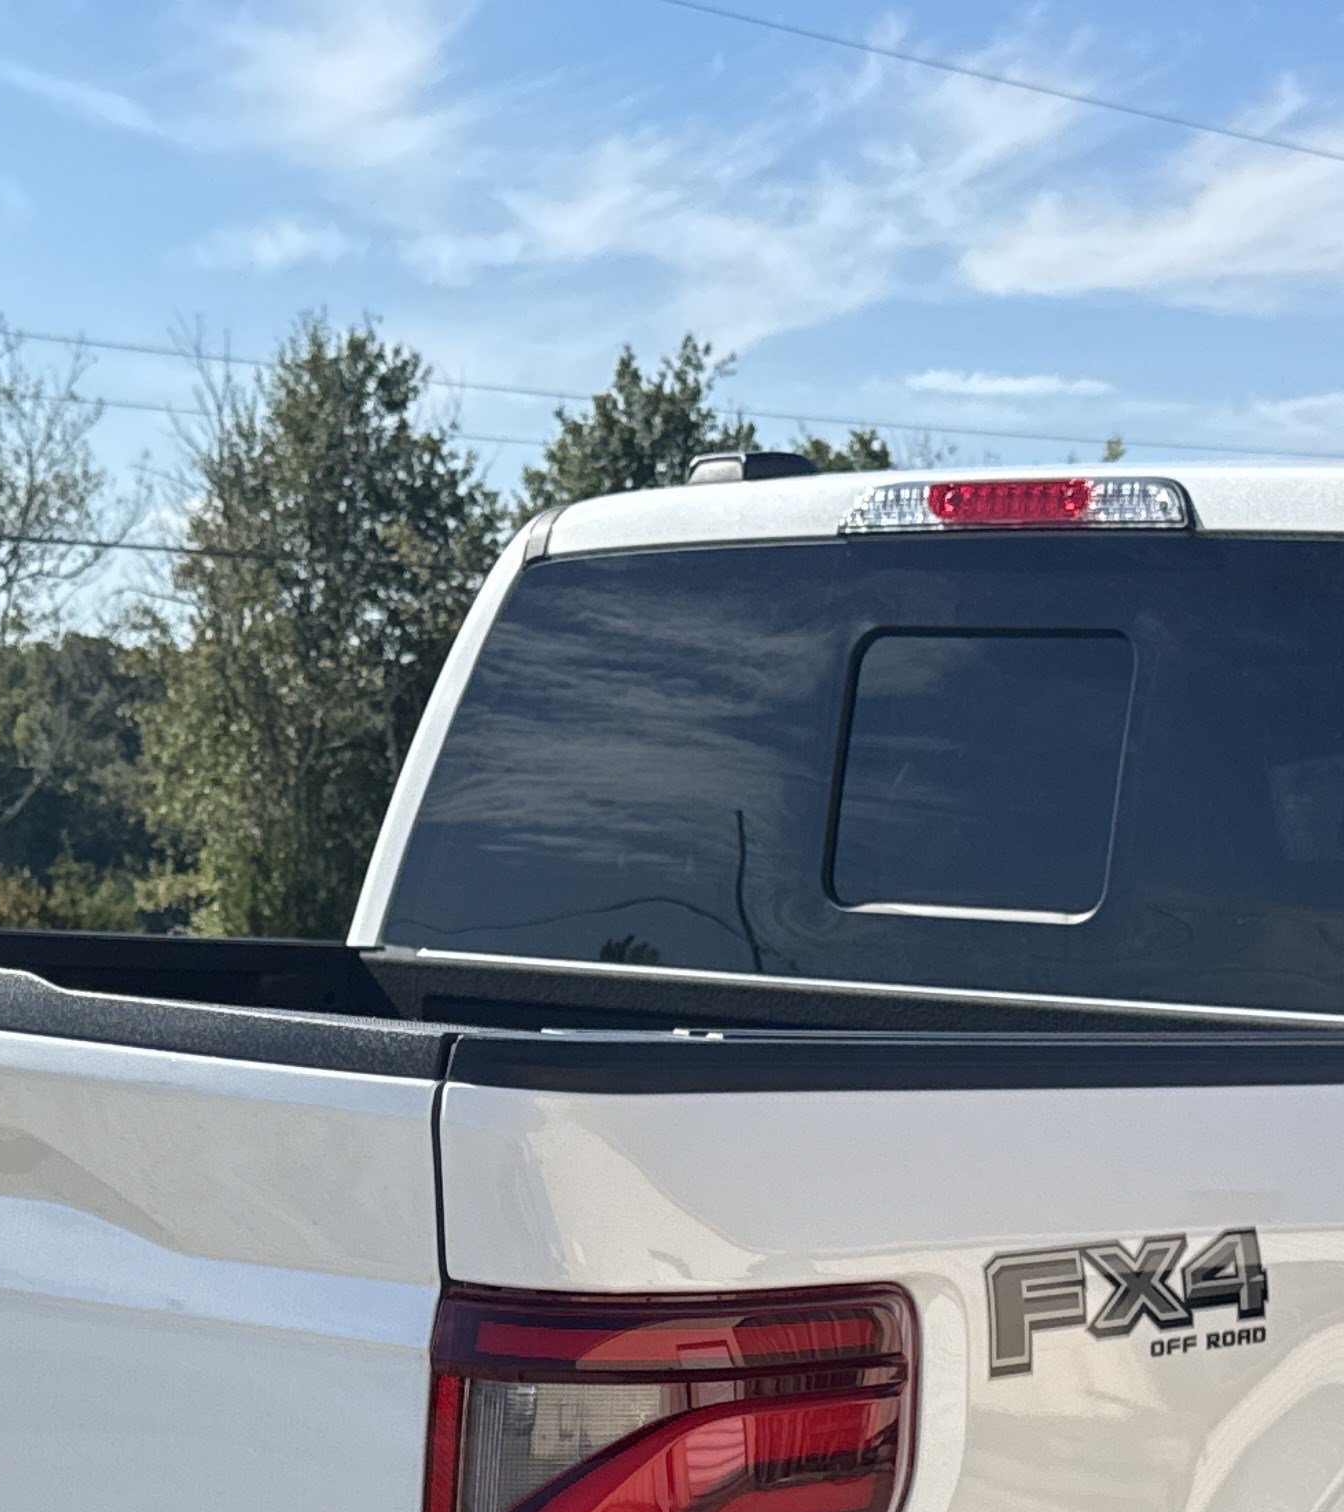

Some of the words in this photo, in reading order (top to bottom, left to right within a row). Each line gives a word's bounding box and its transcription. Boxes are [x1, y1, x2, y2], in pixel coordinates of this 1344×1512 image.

[983, 1226, 1269, 1381] FX4
[1150, 1334, 1198, 1358] OFF
[1205, 1326, 1267, 1351] ROAD
